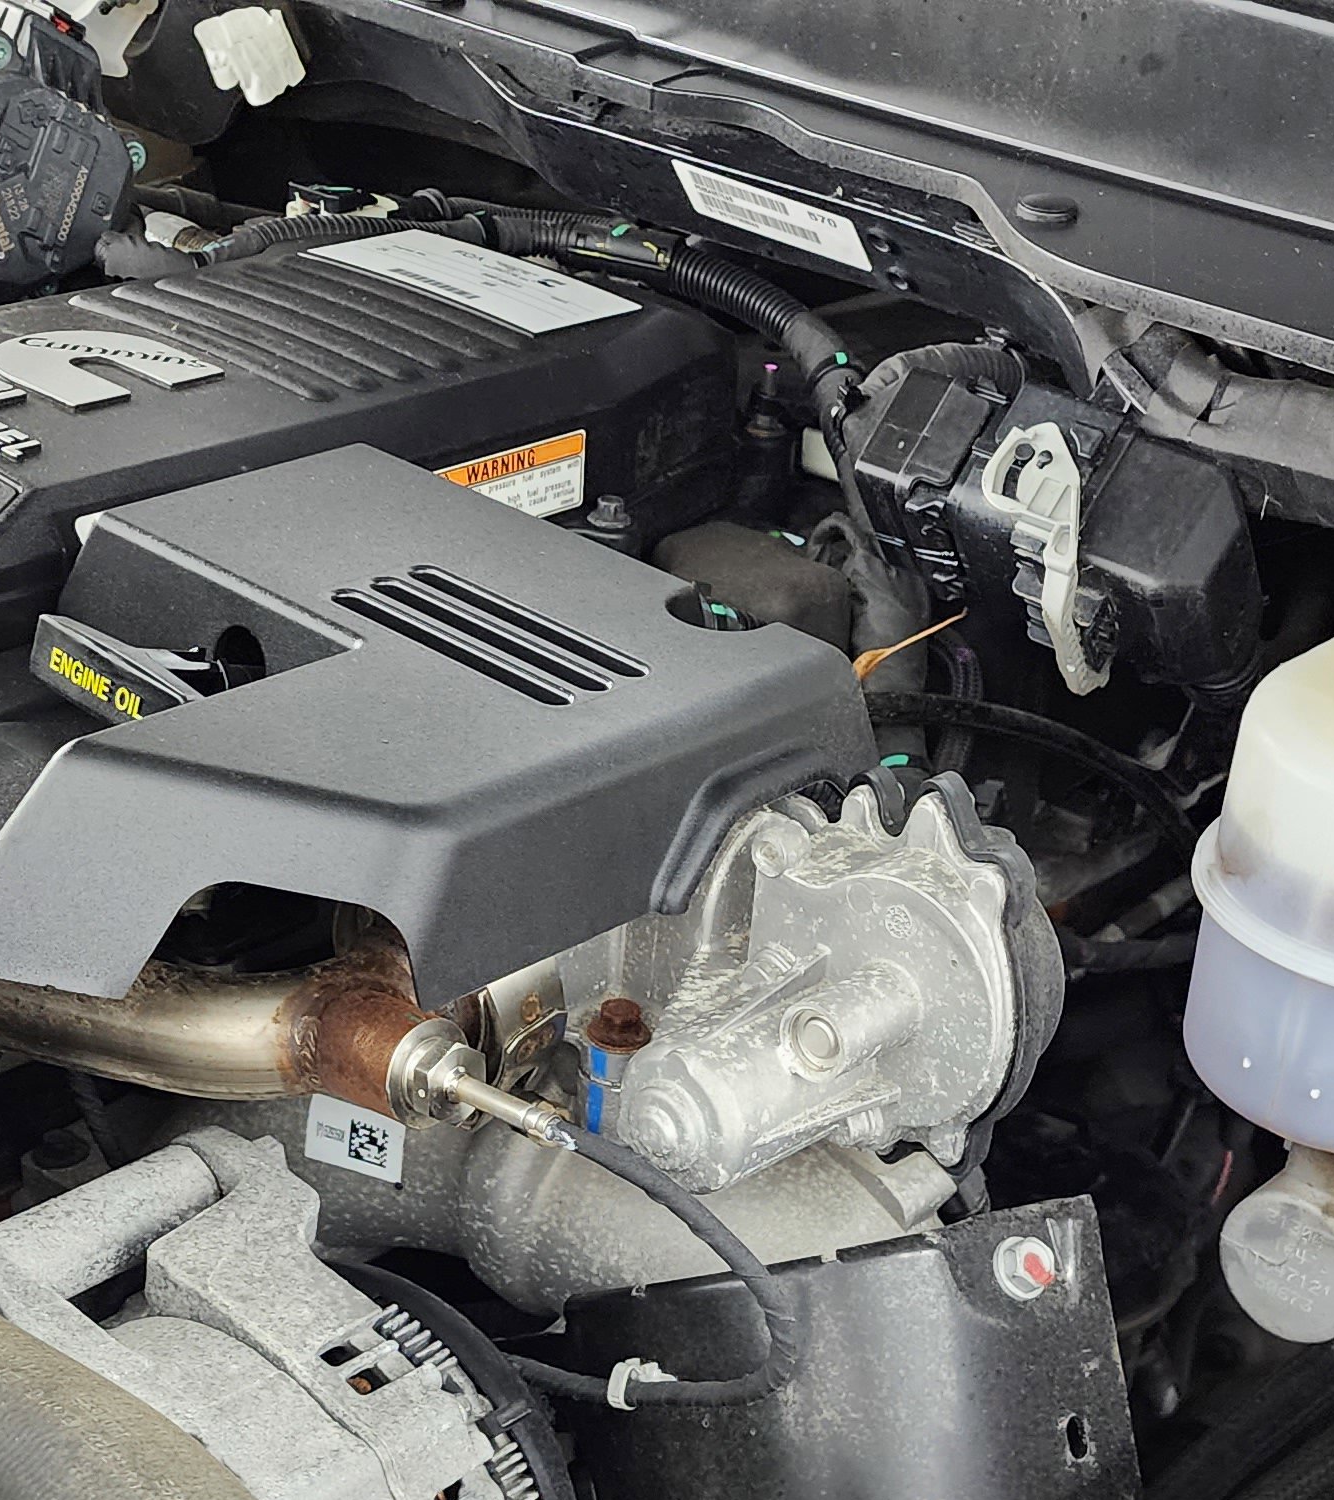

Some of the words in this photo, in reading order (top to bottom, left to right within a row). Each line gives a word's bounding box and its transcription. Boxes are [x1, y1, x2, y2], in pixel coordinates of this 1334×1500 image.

[19, 337, 208, 369] Cummins
[467, 449, 536, 483] WARNING
[49, 646, 112, 702] ENGINE
[114, 686, 144, 721] OIL
